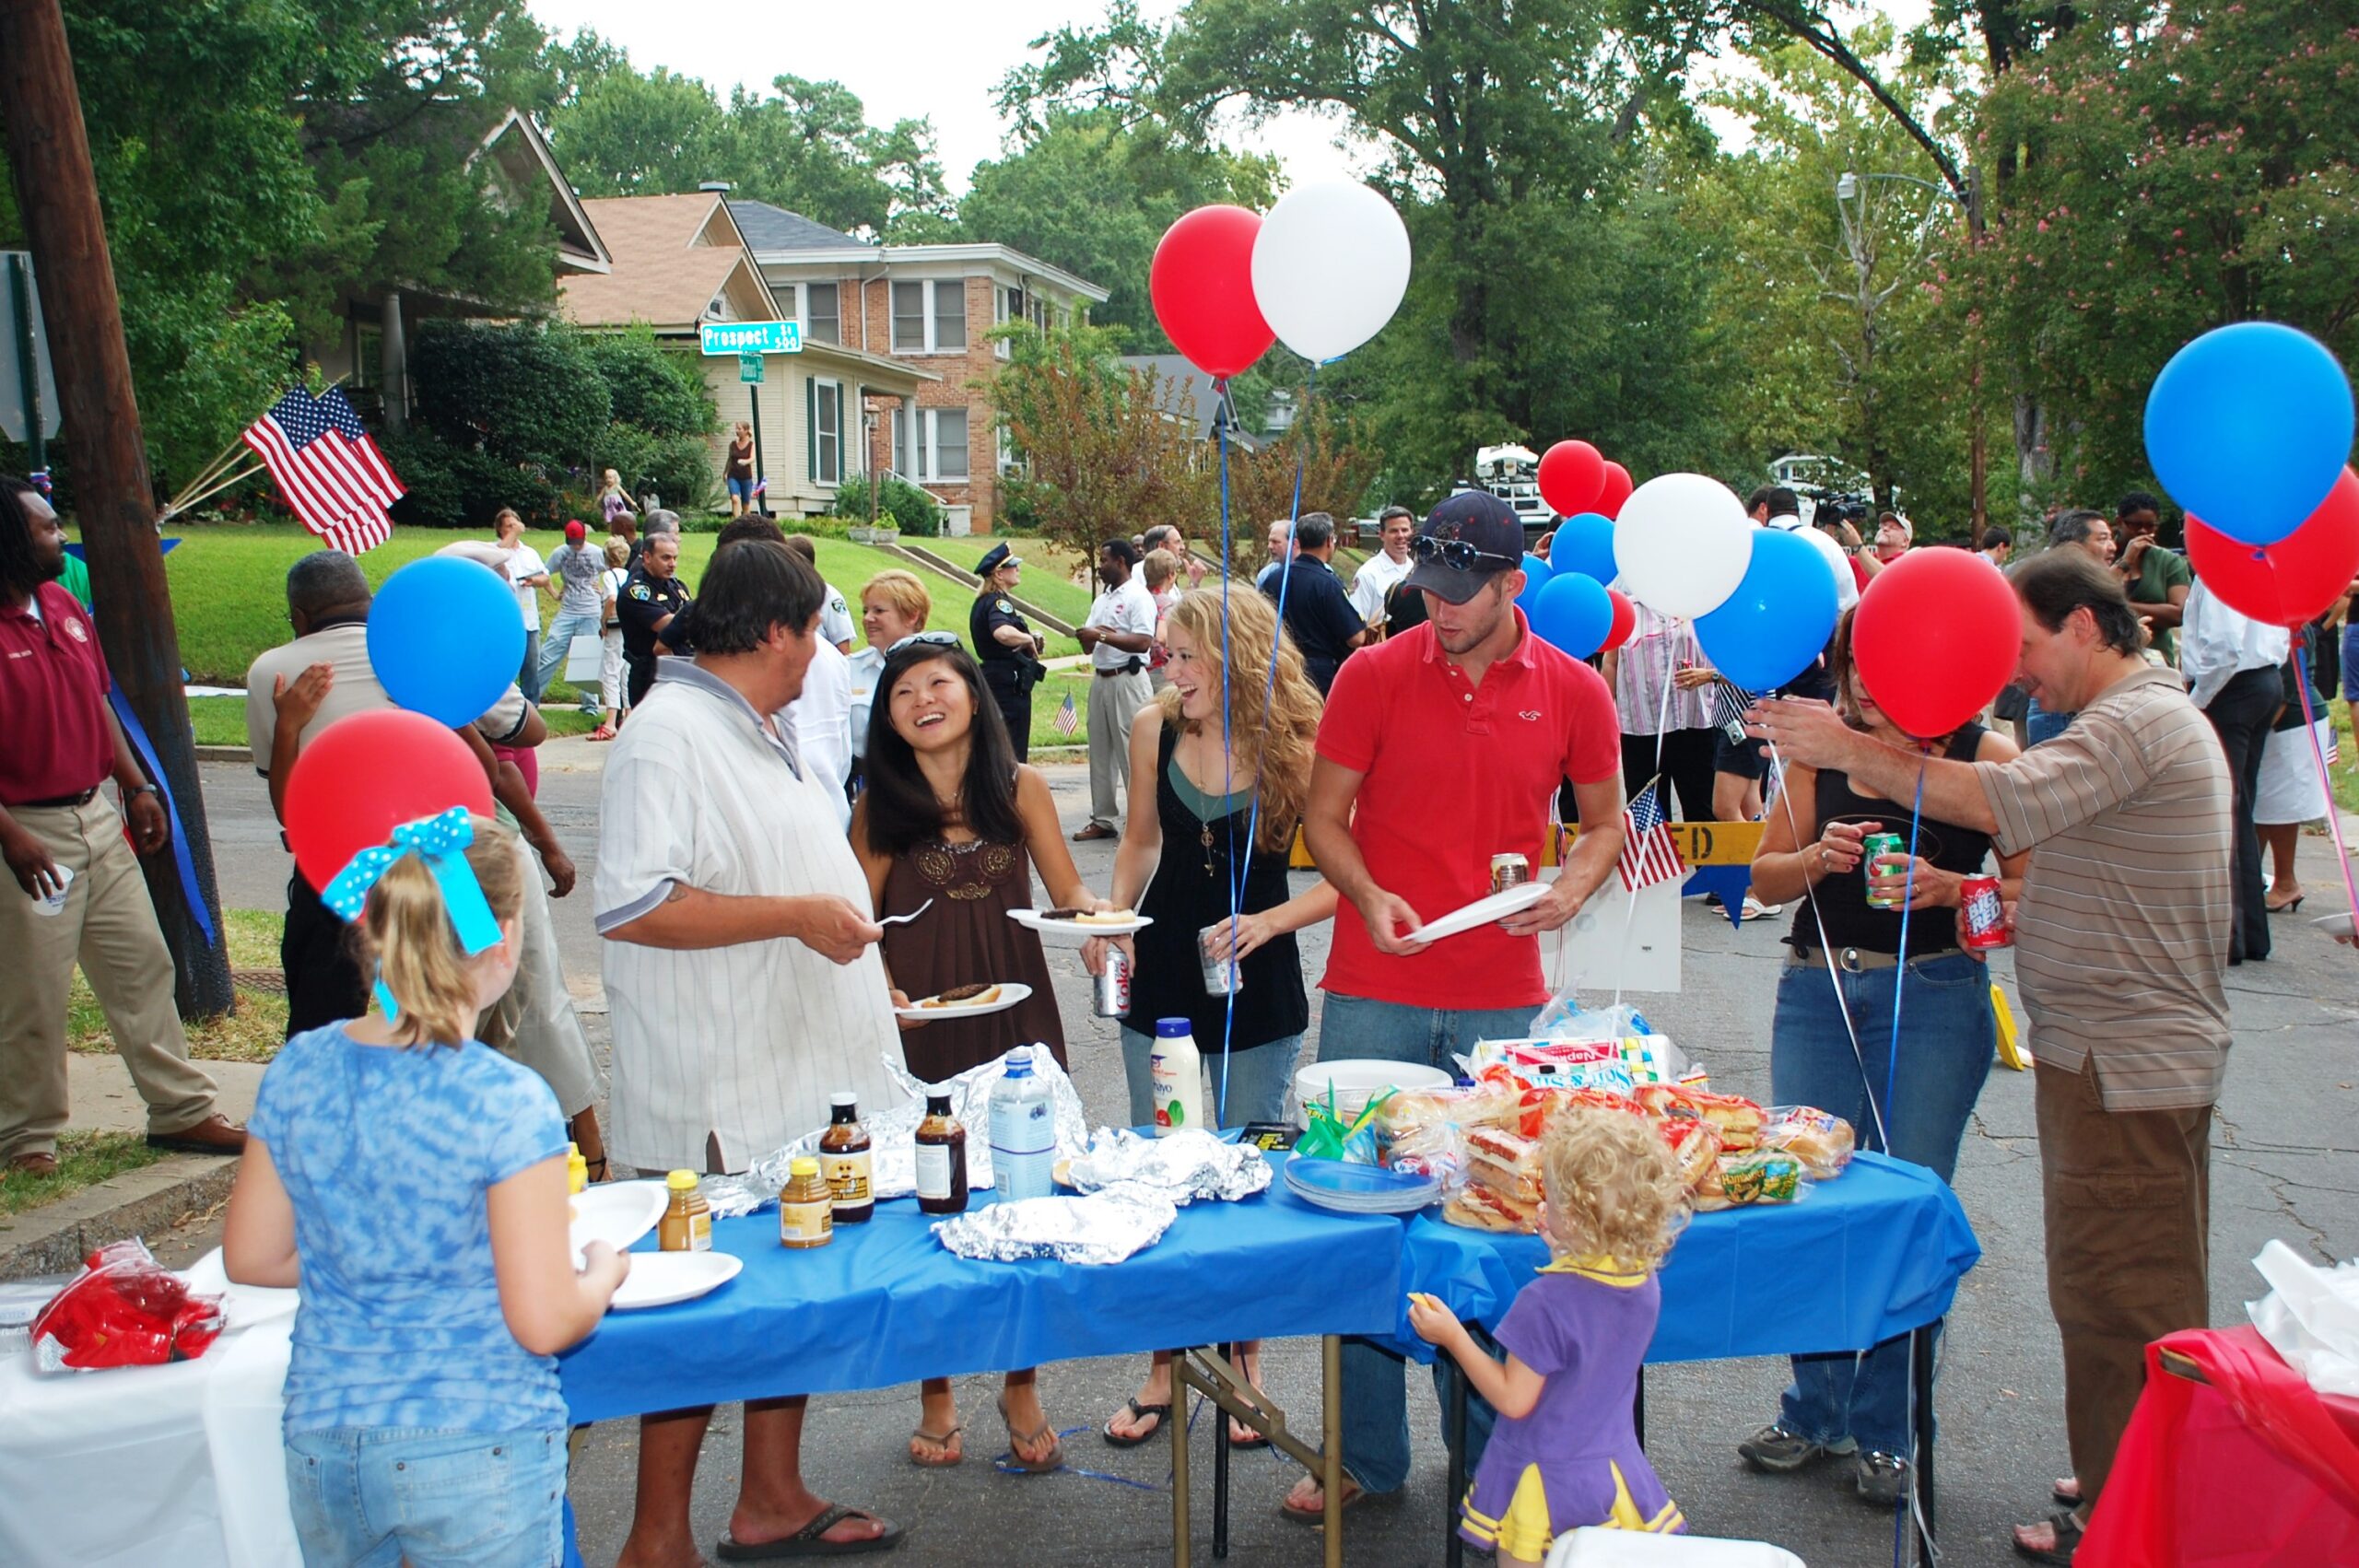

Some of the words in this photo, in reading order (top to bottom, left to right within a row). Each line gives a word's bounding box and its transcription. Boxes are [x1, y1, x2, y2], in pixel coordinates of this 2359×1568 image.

[704, 327, 769, 348] Prospect
[774, 337, 797, 349] 500
[1968, 890, 1996, 920] BIG
[1972, 901, 2001, 934] RED
[1117, 962, 1130, 1010] Coke
